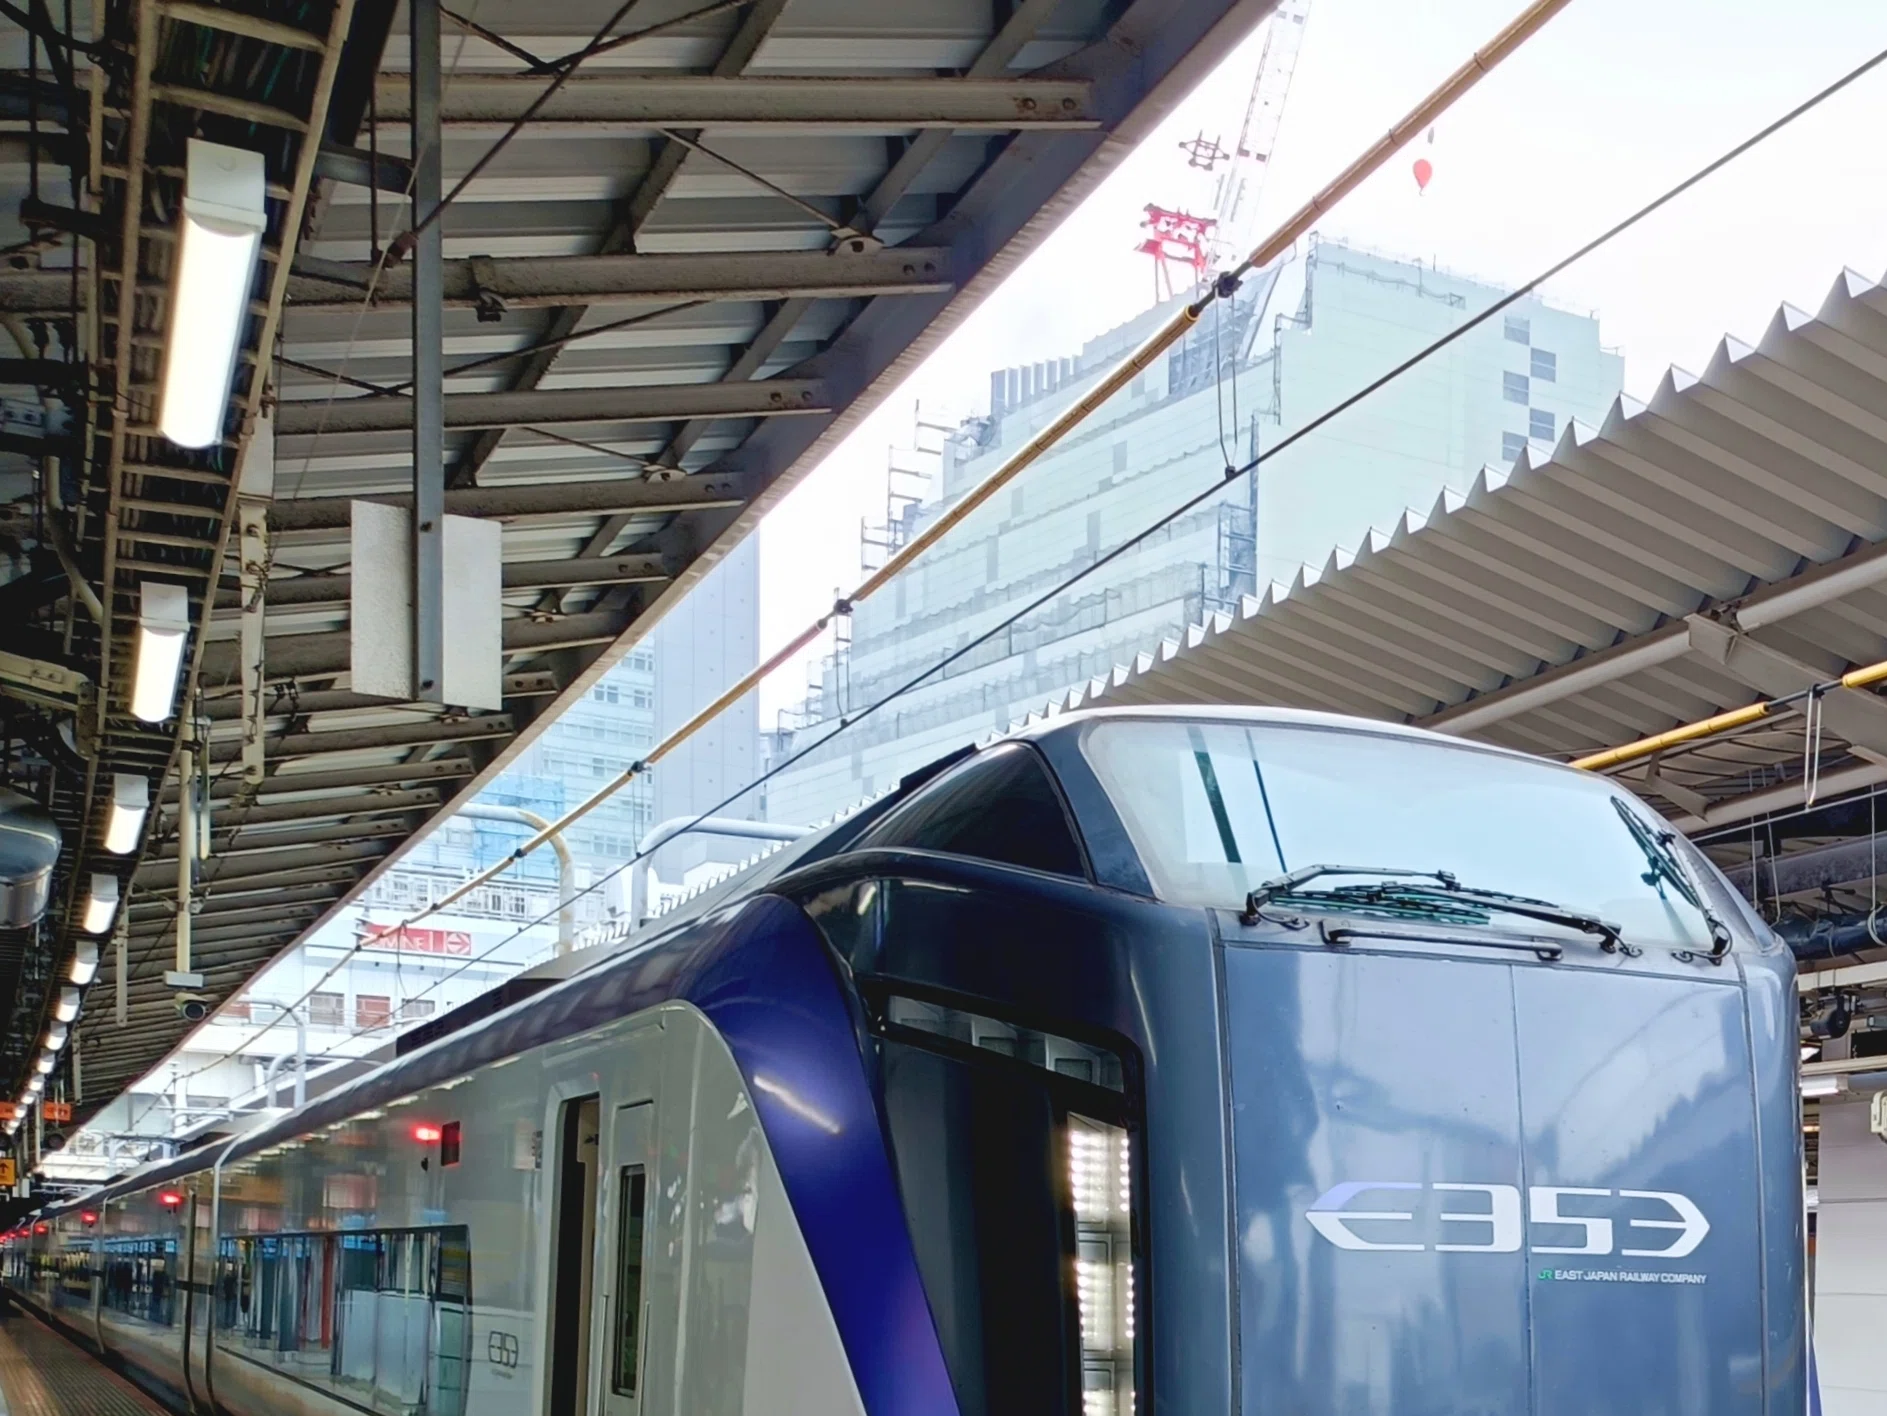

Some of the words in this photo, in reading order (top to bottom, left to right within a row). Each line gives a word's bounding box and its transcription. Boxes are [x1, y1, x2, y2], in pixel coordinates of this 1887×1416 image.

[1305, 1181, 1711, 1258] E353
[1538, 1269, 1553, 1279] JR
[1555, 1270, 1583, 1280] EAST
[1584, 1270, 1618, 1282] JAPAN
[1619, 1271, 1659, 1283] RAILWAY
[1660, 1273, 1707, 1284] COMPANY
